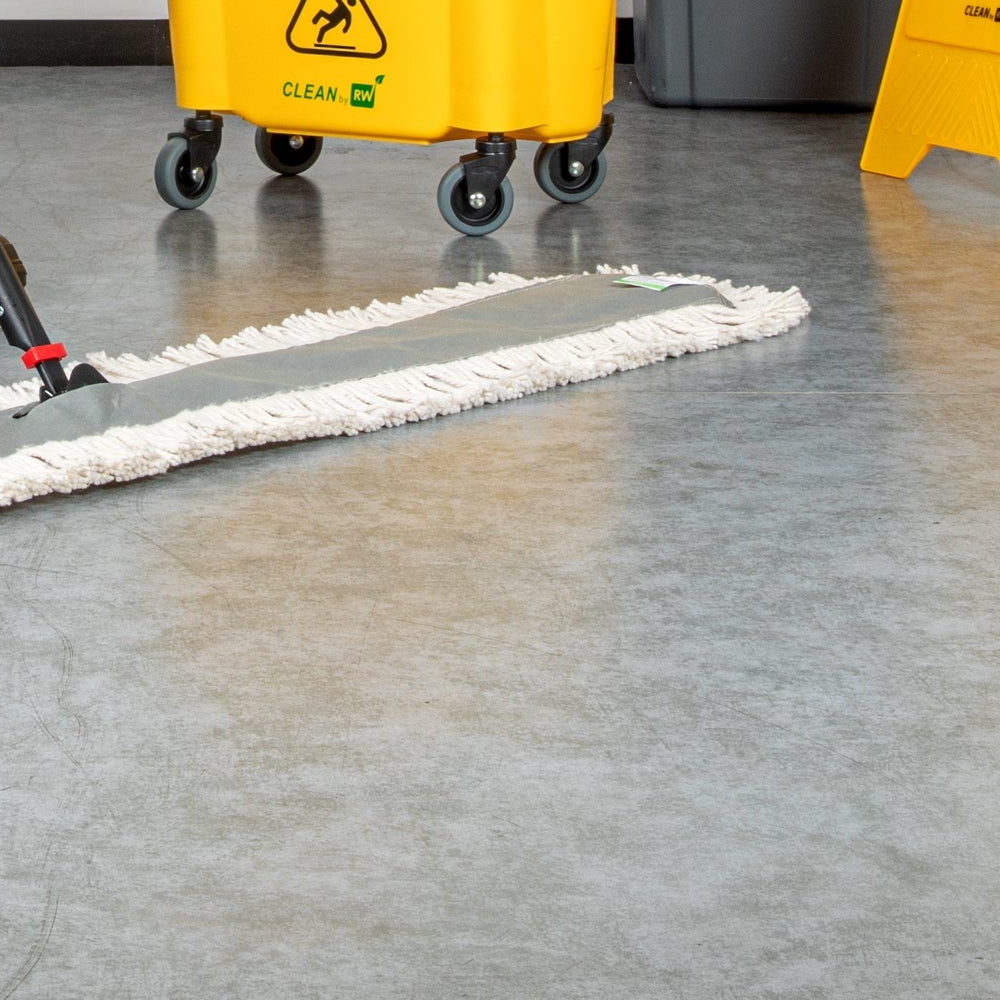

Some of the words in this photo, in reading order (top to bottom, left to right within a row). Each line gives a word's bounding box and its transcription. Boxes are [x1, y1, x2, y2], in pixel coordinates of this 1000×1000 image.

[964, 5, 990, 19] CLEAN
[282, 81, 338, 102] CLEAN
[338, 96, 349, 106] by
[353, 87, 375, 103] RW
